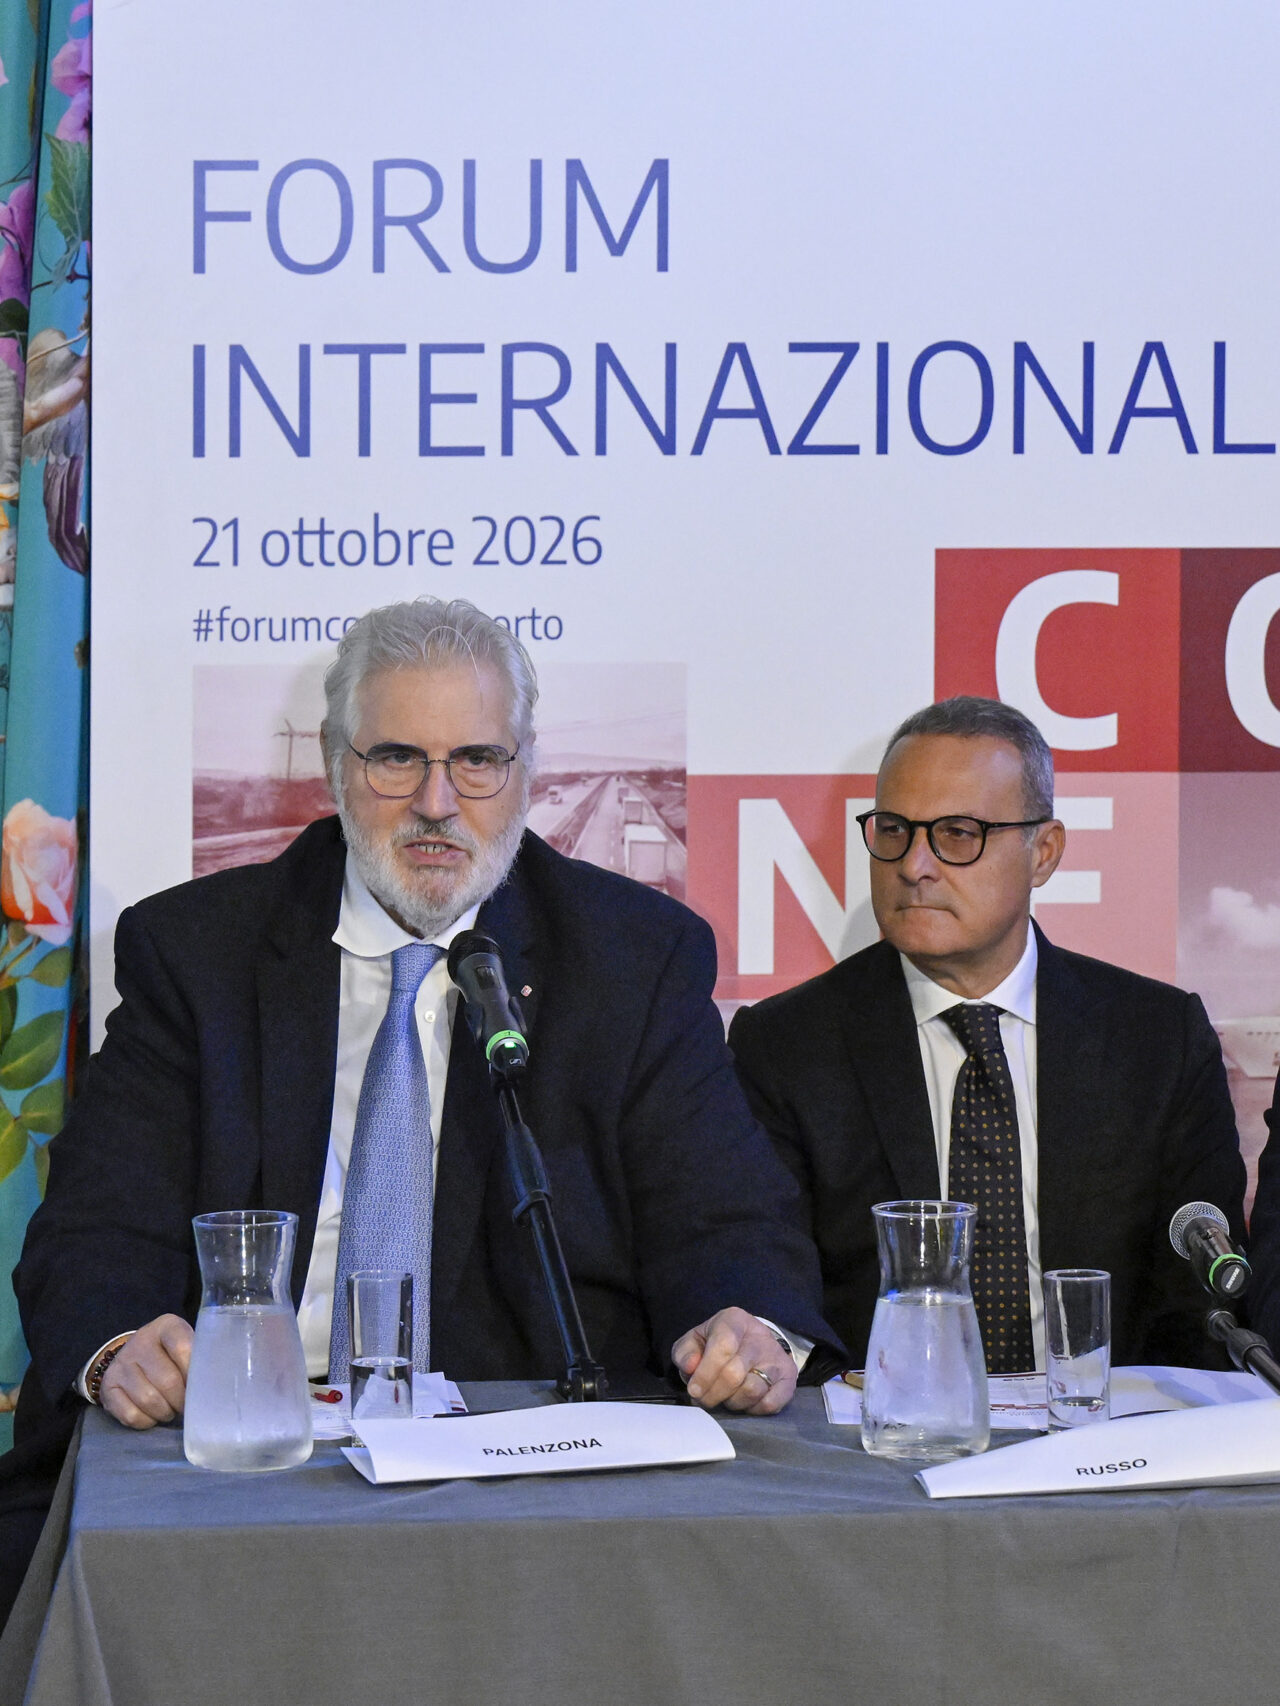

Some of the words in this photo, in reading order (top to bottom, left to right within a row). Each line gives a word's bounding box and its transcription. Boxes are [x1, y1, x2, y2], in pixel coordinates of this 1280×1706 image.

[192, 157, 670, 276] FORUM
[192, 516, 239, 568] 21
[260, 512, 455, 568] ottobre
[471, 514, 604, 567] 2026
[482, 1438, 603, 1456] PALENZONA
[1076, 1458, 1148, 1476] RUSSO
